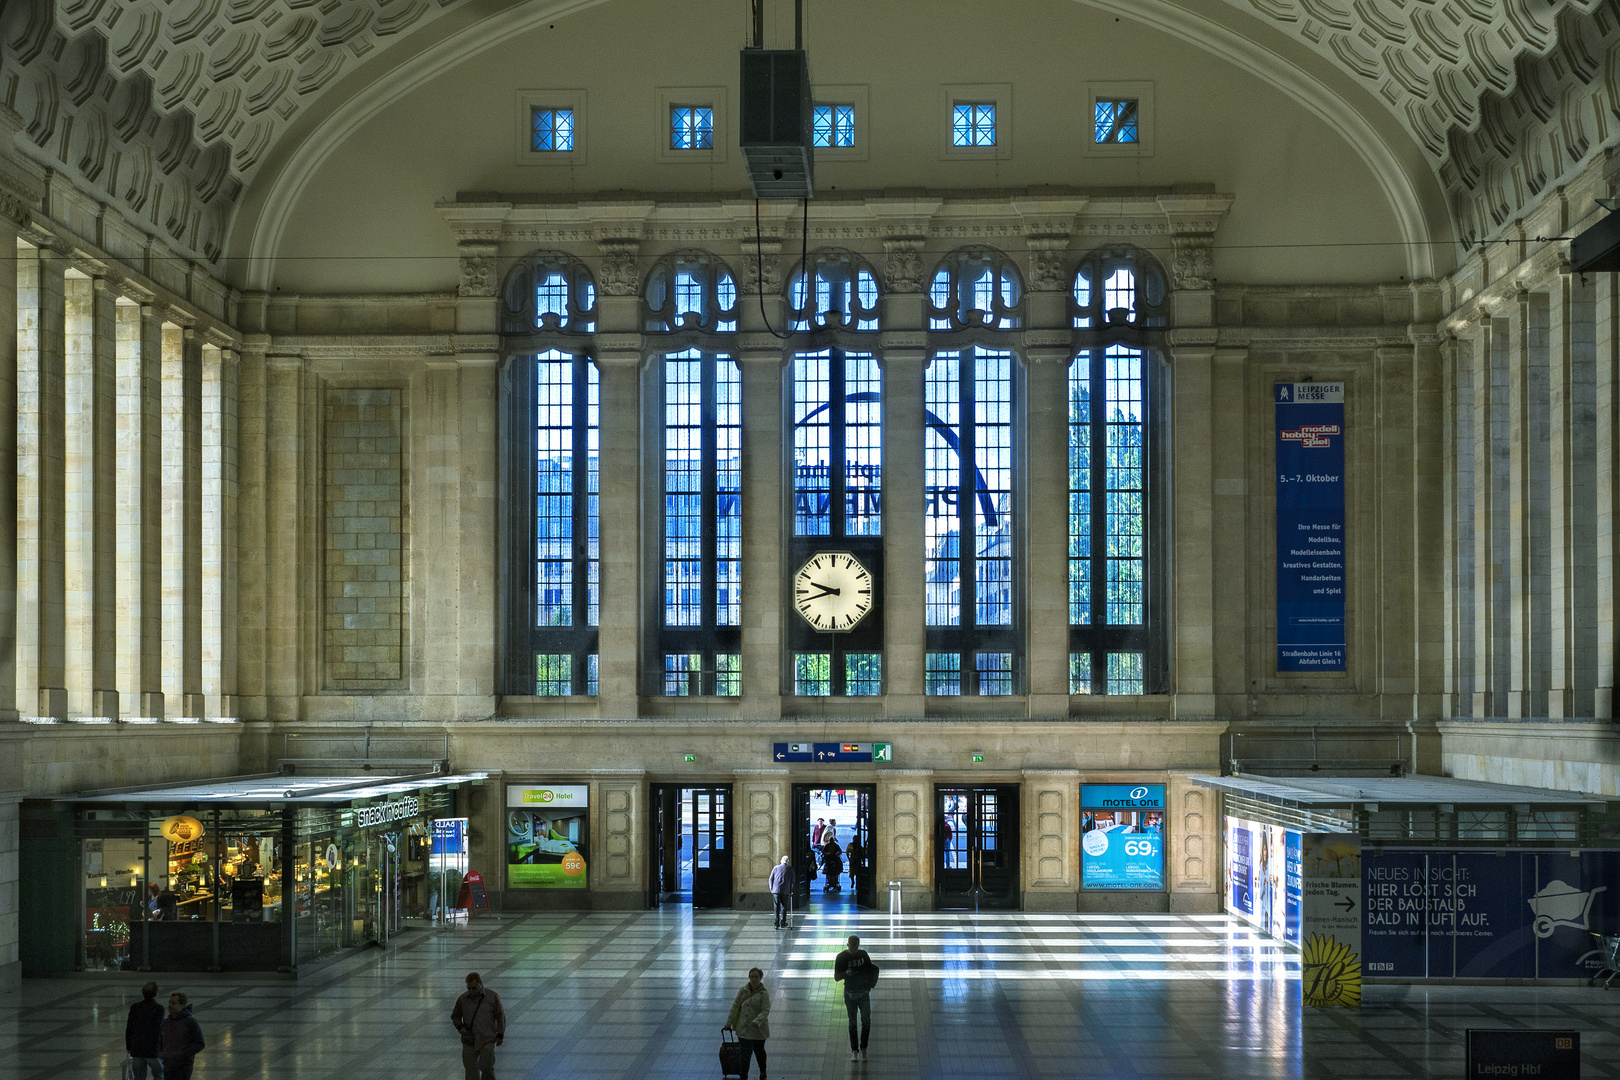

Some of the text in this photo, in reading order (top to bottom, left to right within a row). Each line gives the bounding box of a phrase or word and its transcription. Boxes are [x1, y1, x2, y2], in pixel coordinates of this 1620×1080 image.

[1282, 431, 1316, 440] hobby
[1306, 474, 1339, 482] Oktober
[556, 792, 573, 800] Hotel
[393, 796, 419, 821] coffee
[565, 862, 581, 870] 59€
[1368, 868, 1409, 881] NEUES
[1414, 868, 1426, 881] IN
[1368, 884, 1398, 896] HIER
[1444, 884, 1476, 896] SCH
[1368, 898, 1393, 911] DER
[1368, 912, 1401, 925] BALD
[1406, 912, 1419, 925] IN
[1460, 912, 1490, 926] AUF.
[1473, 929, 1494, 937] Center.
[1556, 1038, 1572, 1048] DB
[1478, 1063, 1542, 1076] Leipzig Hbf
